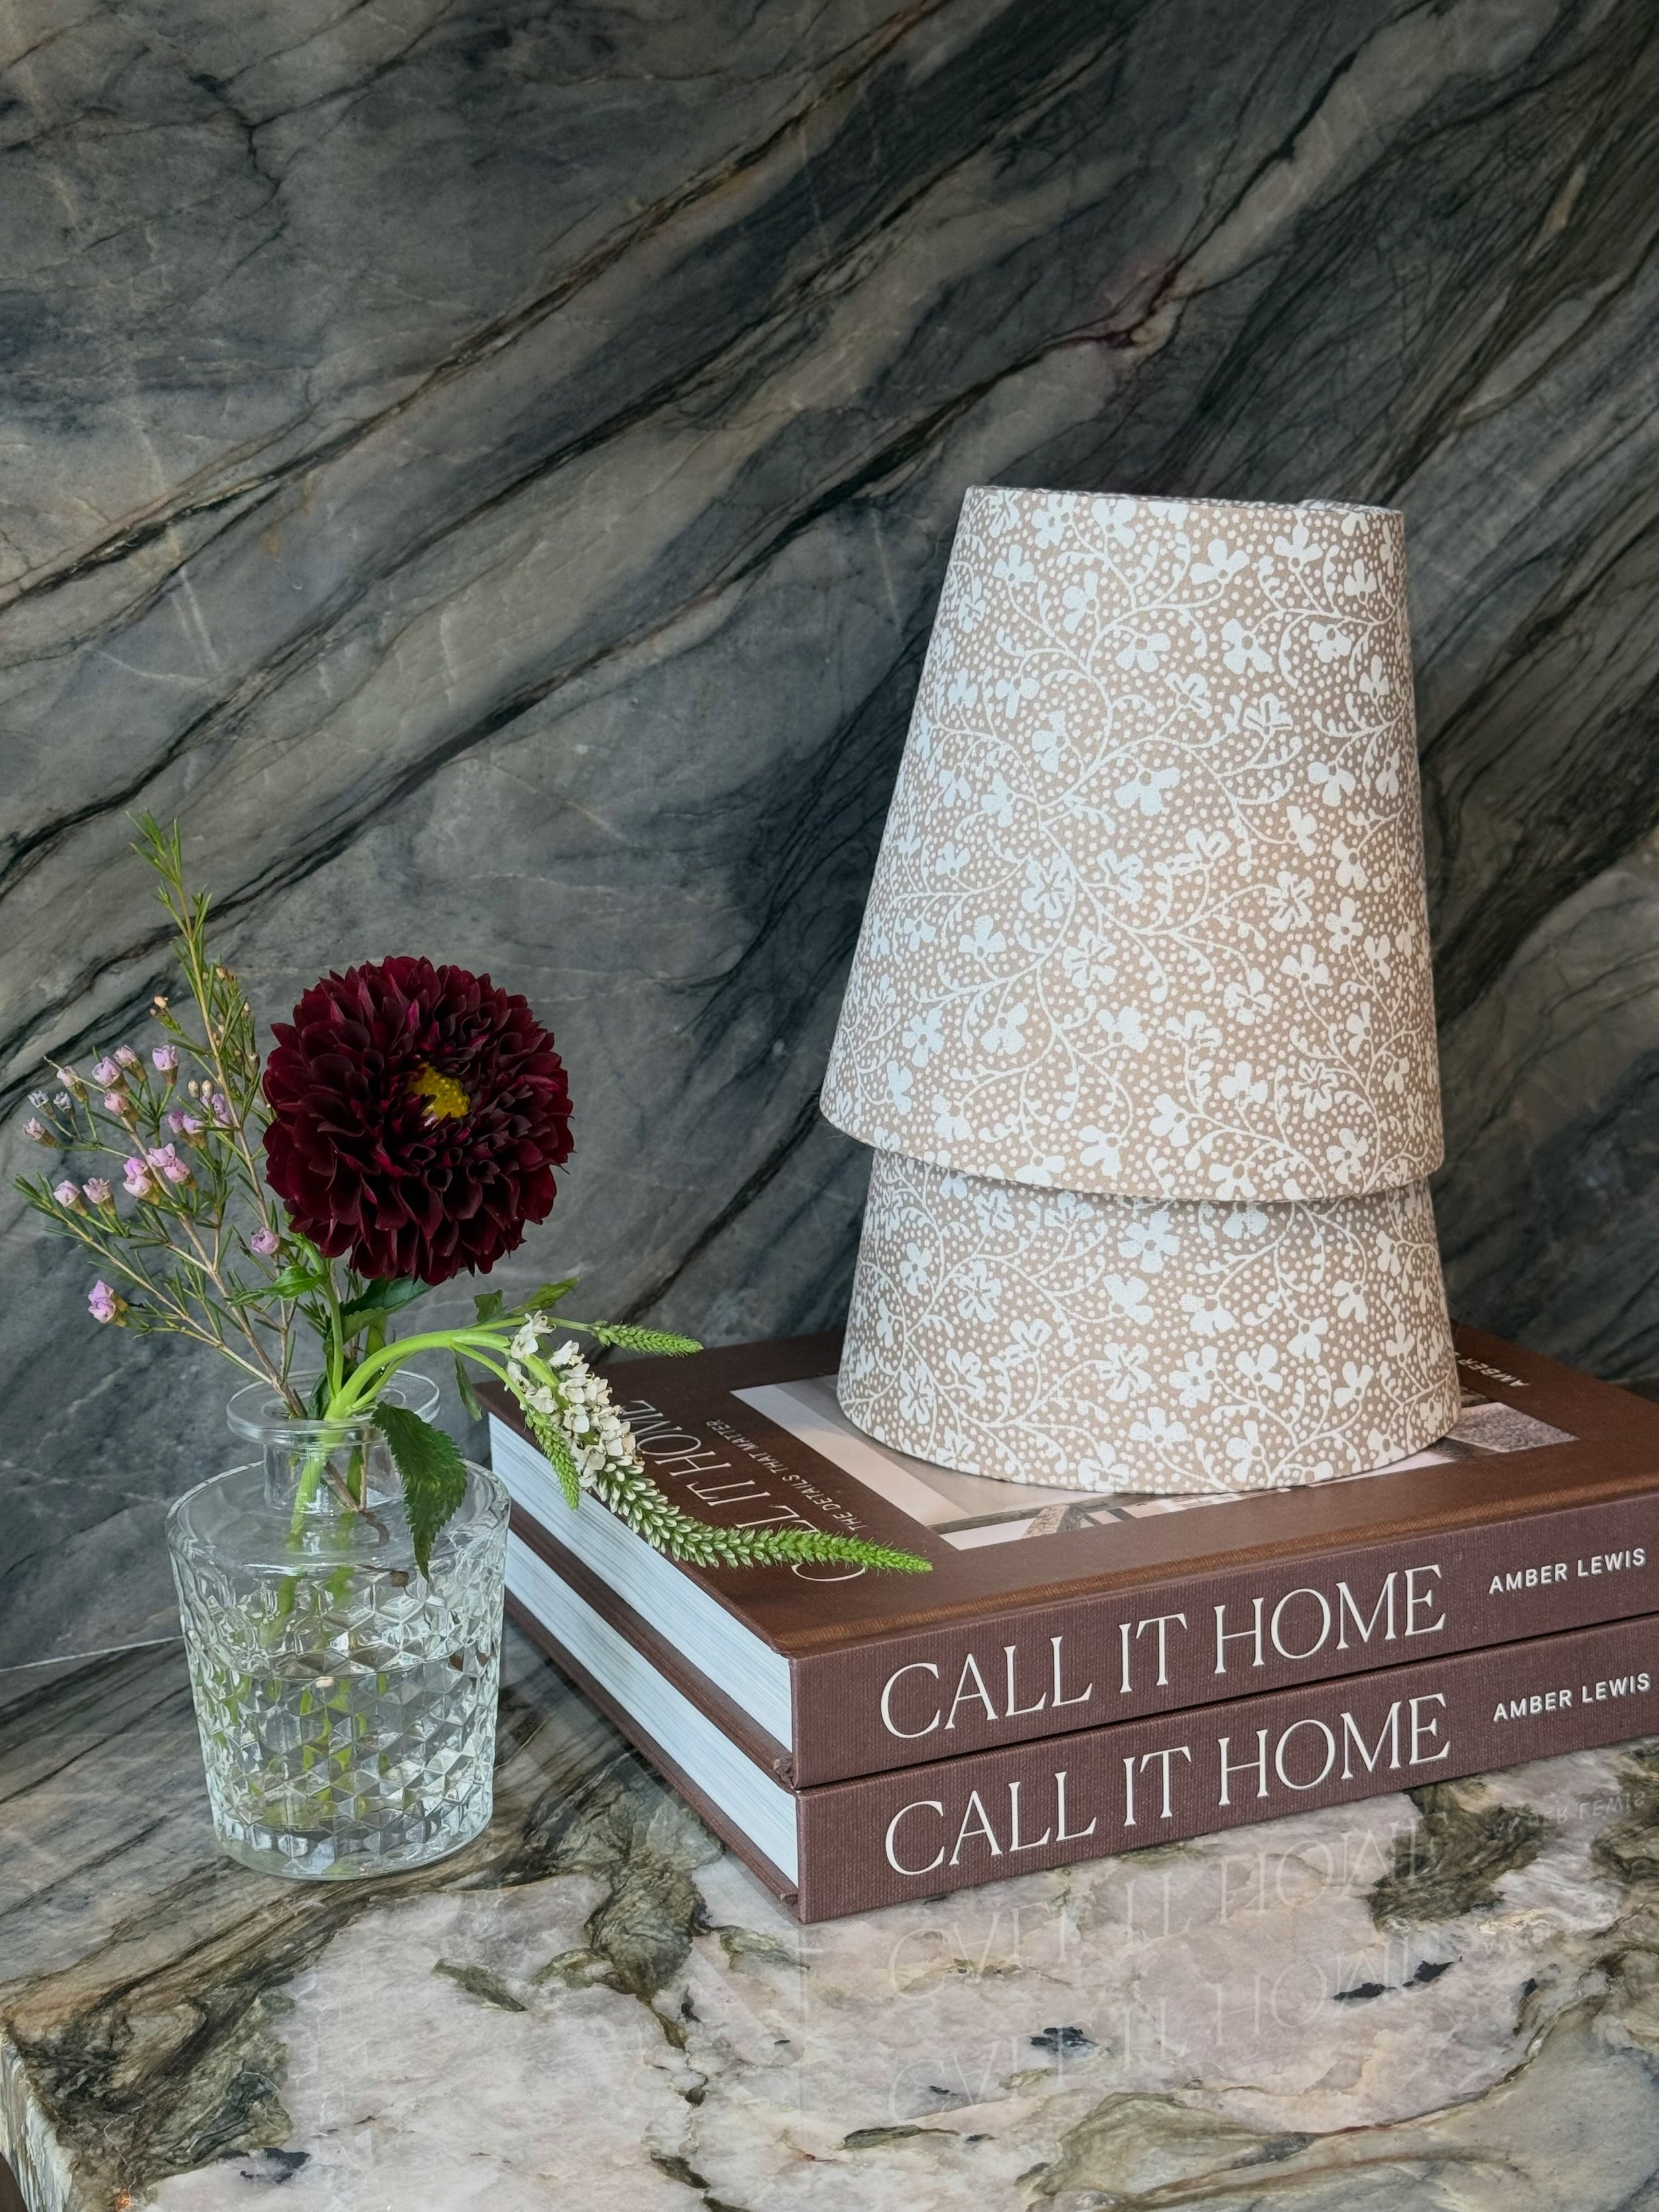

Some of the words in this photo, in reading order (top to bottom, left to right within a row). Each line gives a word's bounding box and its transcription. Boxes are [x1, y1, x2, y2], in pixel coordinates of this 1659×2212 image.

[706, 1419, 759, 1451] MATTER
[749, 1452, 788, 1474] THAT
[686, 1480, 770, 1507] IT
[782, 1474, 841, 1511] DETAILS
[833, 1511, 867, 1531] THE
[1489, 1563, 1567, 1594] AMBER
[1577, 1548, 1646, 1578] LEWIS
[881, 1636, 1092, 1738] CALL
[1119, 1613, 1188, 1694] IT
[1214, 1564, 1446, 1674] HOME
[1493, 1689, 1572, 1722] AMBER
[1582, 1672, 1650, 1703] LEWIS
[885, 1771, 1097, 1876] CALL
[1123, 1746, 1192, 1826] IT
[1218, 1692, 1451, 1806] HOME
